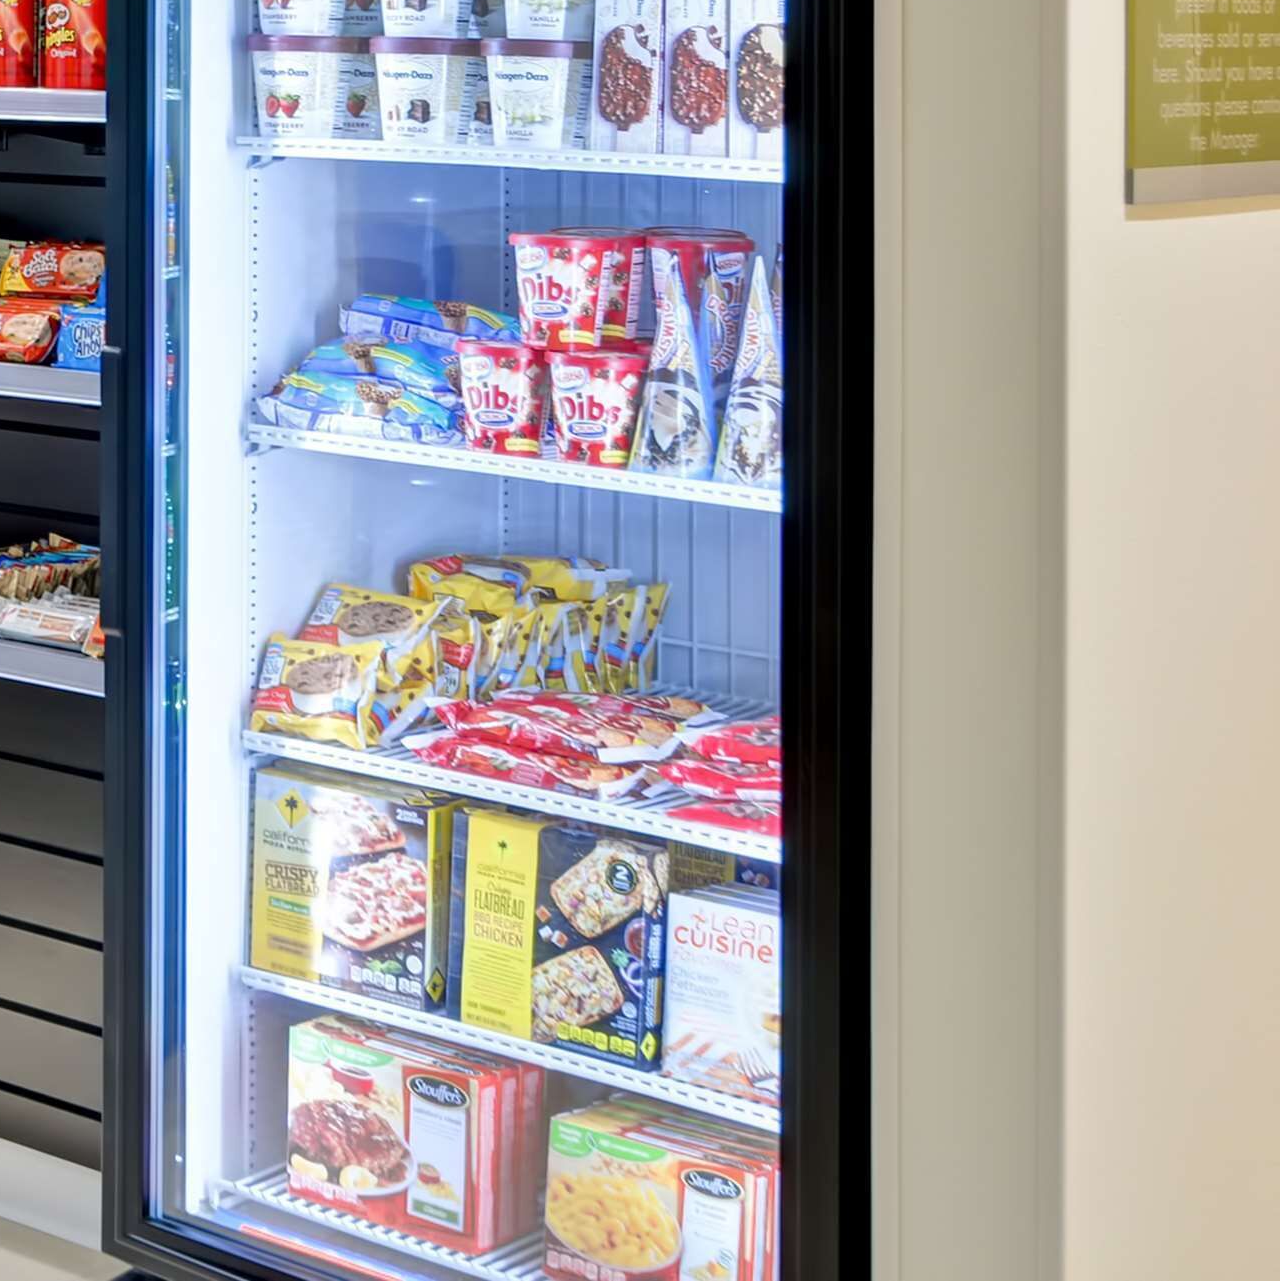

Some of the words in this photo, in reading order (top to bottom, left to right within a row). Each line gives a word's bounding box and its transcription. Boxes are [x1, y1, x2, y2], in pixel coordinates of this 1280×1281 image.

[1217, 24, 1240, 49] sold
[1242, 30, 1255, 49] or
[1257, 30, 1280, 49] serv
[1184, 58, 1223, 83] Should
[1225, 65, 1245, 89] you
[1214, 93, 1249, 122] please
[521, 272, 579, 306] Dibs
[71, 324, 102, 344] Chips
[467, 381, 518, 414] Dibs
[560, 392, 622, 424] Dibs
[264, 863, 319, 884] CRISPY
[473, 888, 525, 920] FLATBREAD
[473, 923, 523, 949] CHICKEN
[710, 910, 775, 945] Lean
[673, 924, 774, 965] cuisine
[414, 1076, 464, 1106] Stouffer's
